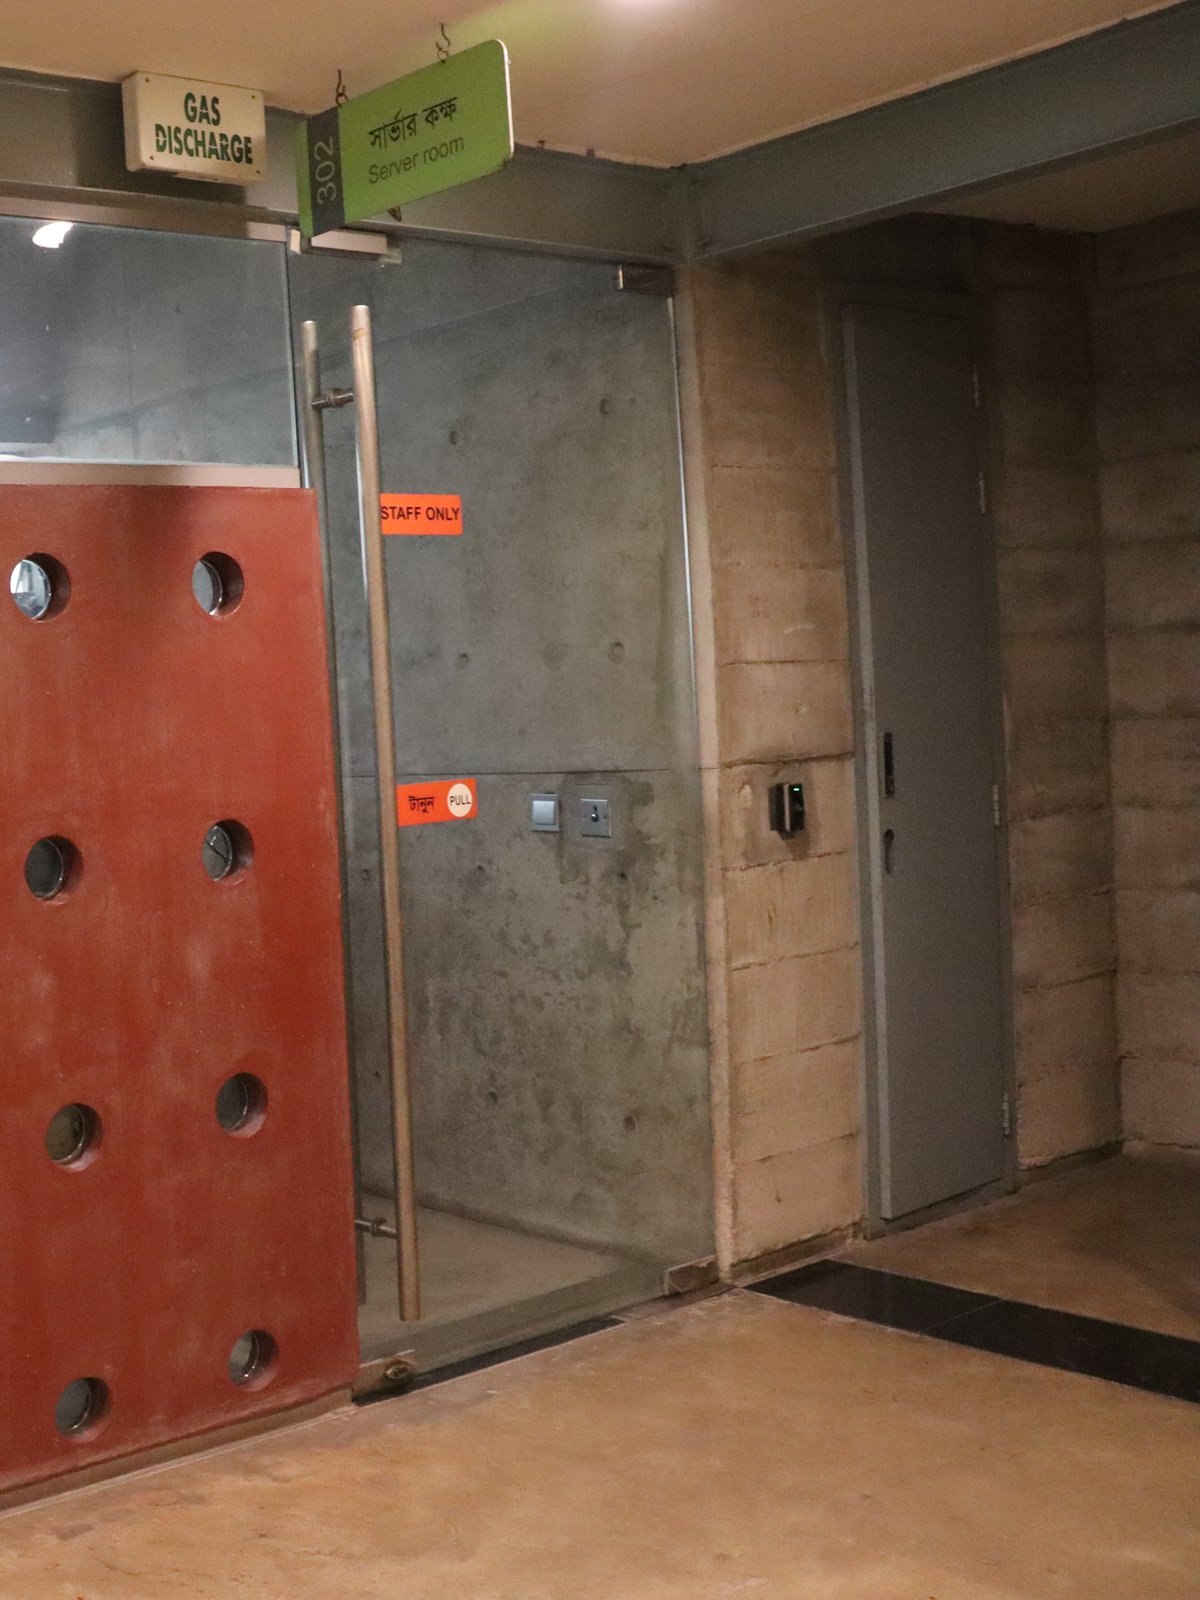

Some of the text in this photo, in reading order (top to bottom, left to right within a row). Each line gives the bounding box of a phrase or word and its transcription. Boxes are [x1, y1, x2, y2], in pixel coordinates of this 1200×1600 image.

[184, 92, 220, 126] GAS
[368, 97, 458, 150] সার্ভার কক্ষ
[155, 123, 253, 165] DISCHARGE
[368, 136, 465, 184] Server room
[314, 136, 337, 205] 302
[380, 506, 460, 521] STAFF ONLY
[450, 795, 471, 806] PULL
